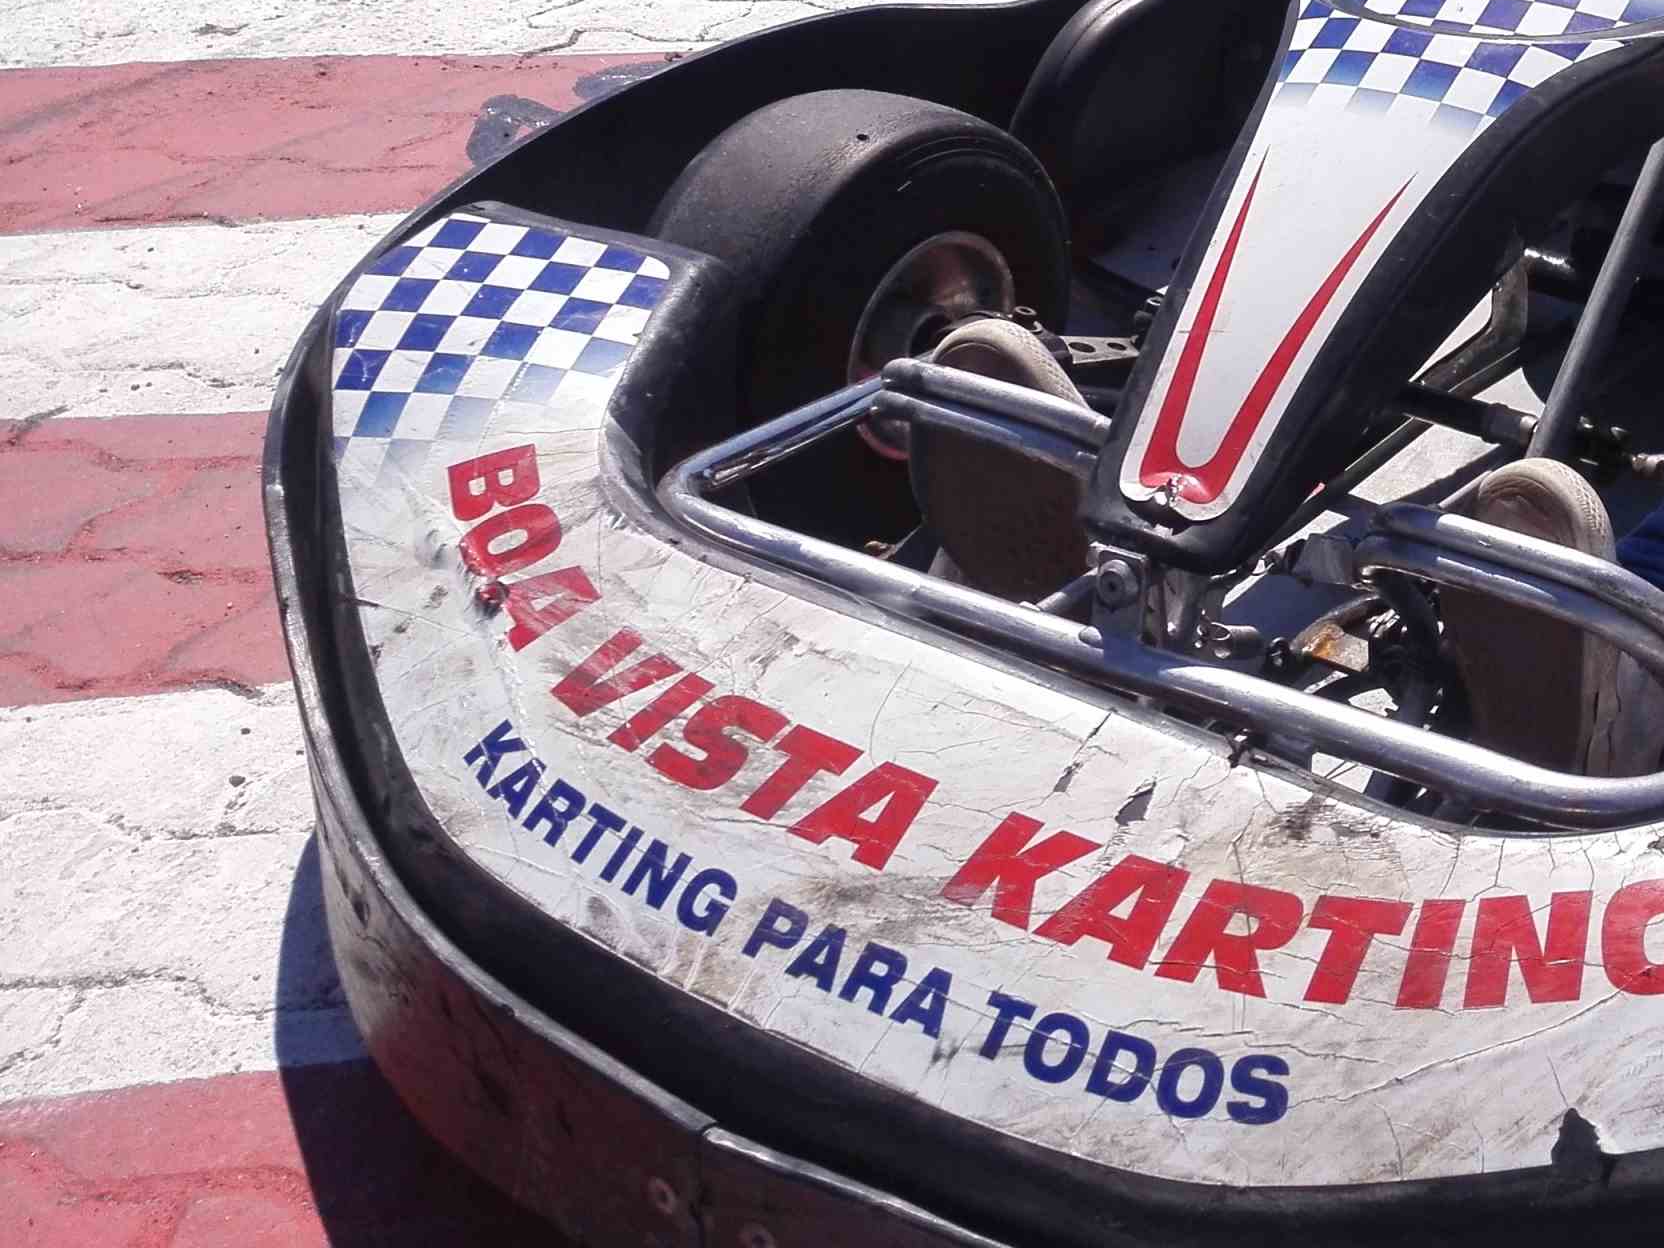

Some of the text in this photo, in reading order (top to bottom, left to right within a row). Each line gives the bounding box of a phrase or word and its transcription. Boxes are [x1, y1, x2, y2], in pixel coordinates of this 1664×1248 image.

[447, 443, 601, 652] BOA
[551, 629, 939, 871] VISTA
[463, 719, 1291, 1125] KARTING PARA TODOS
